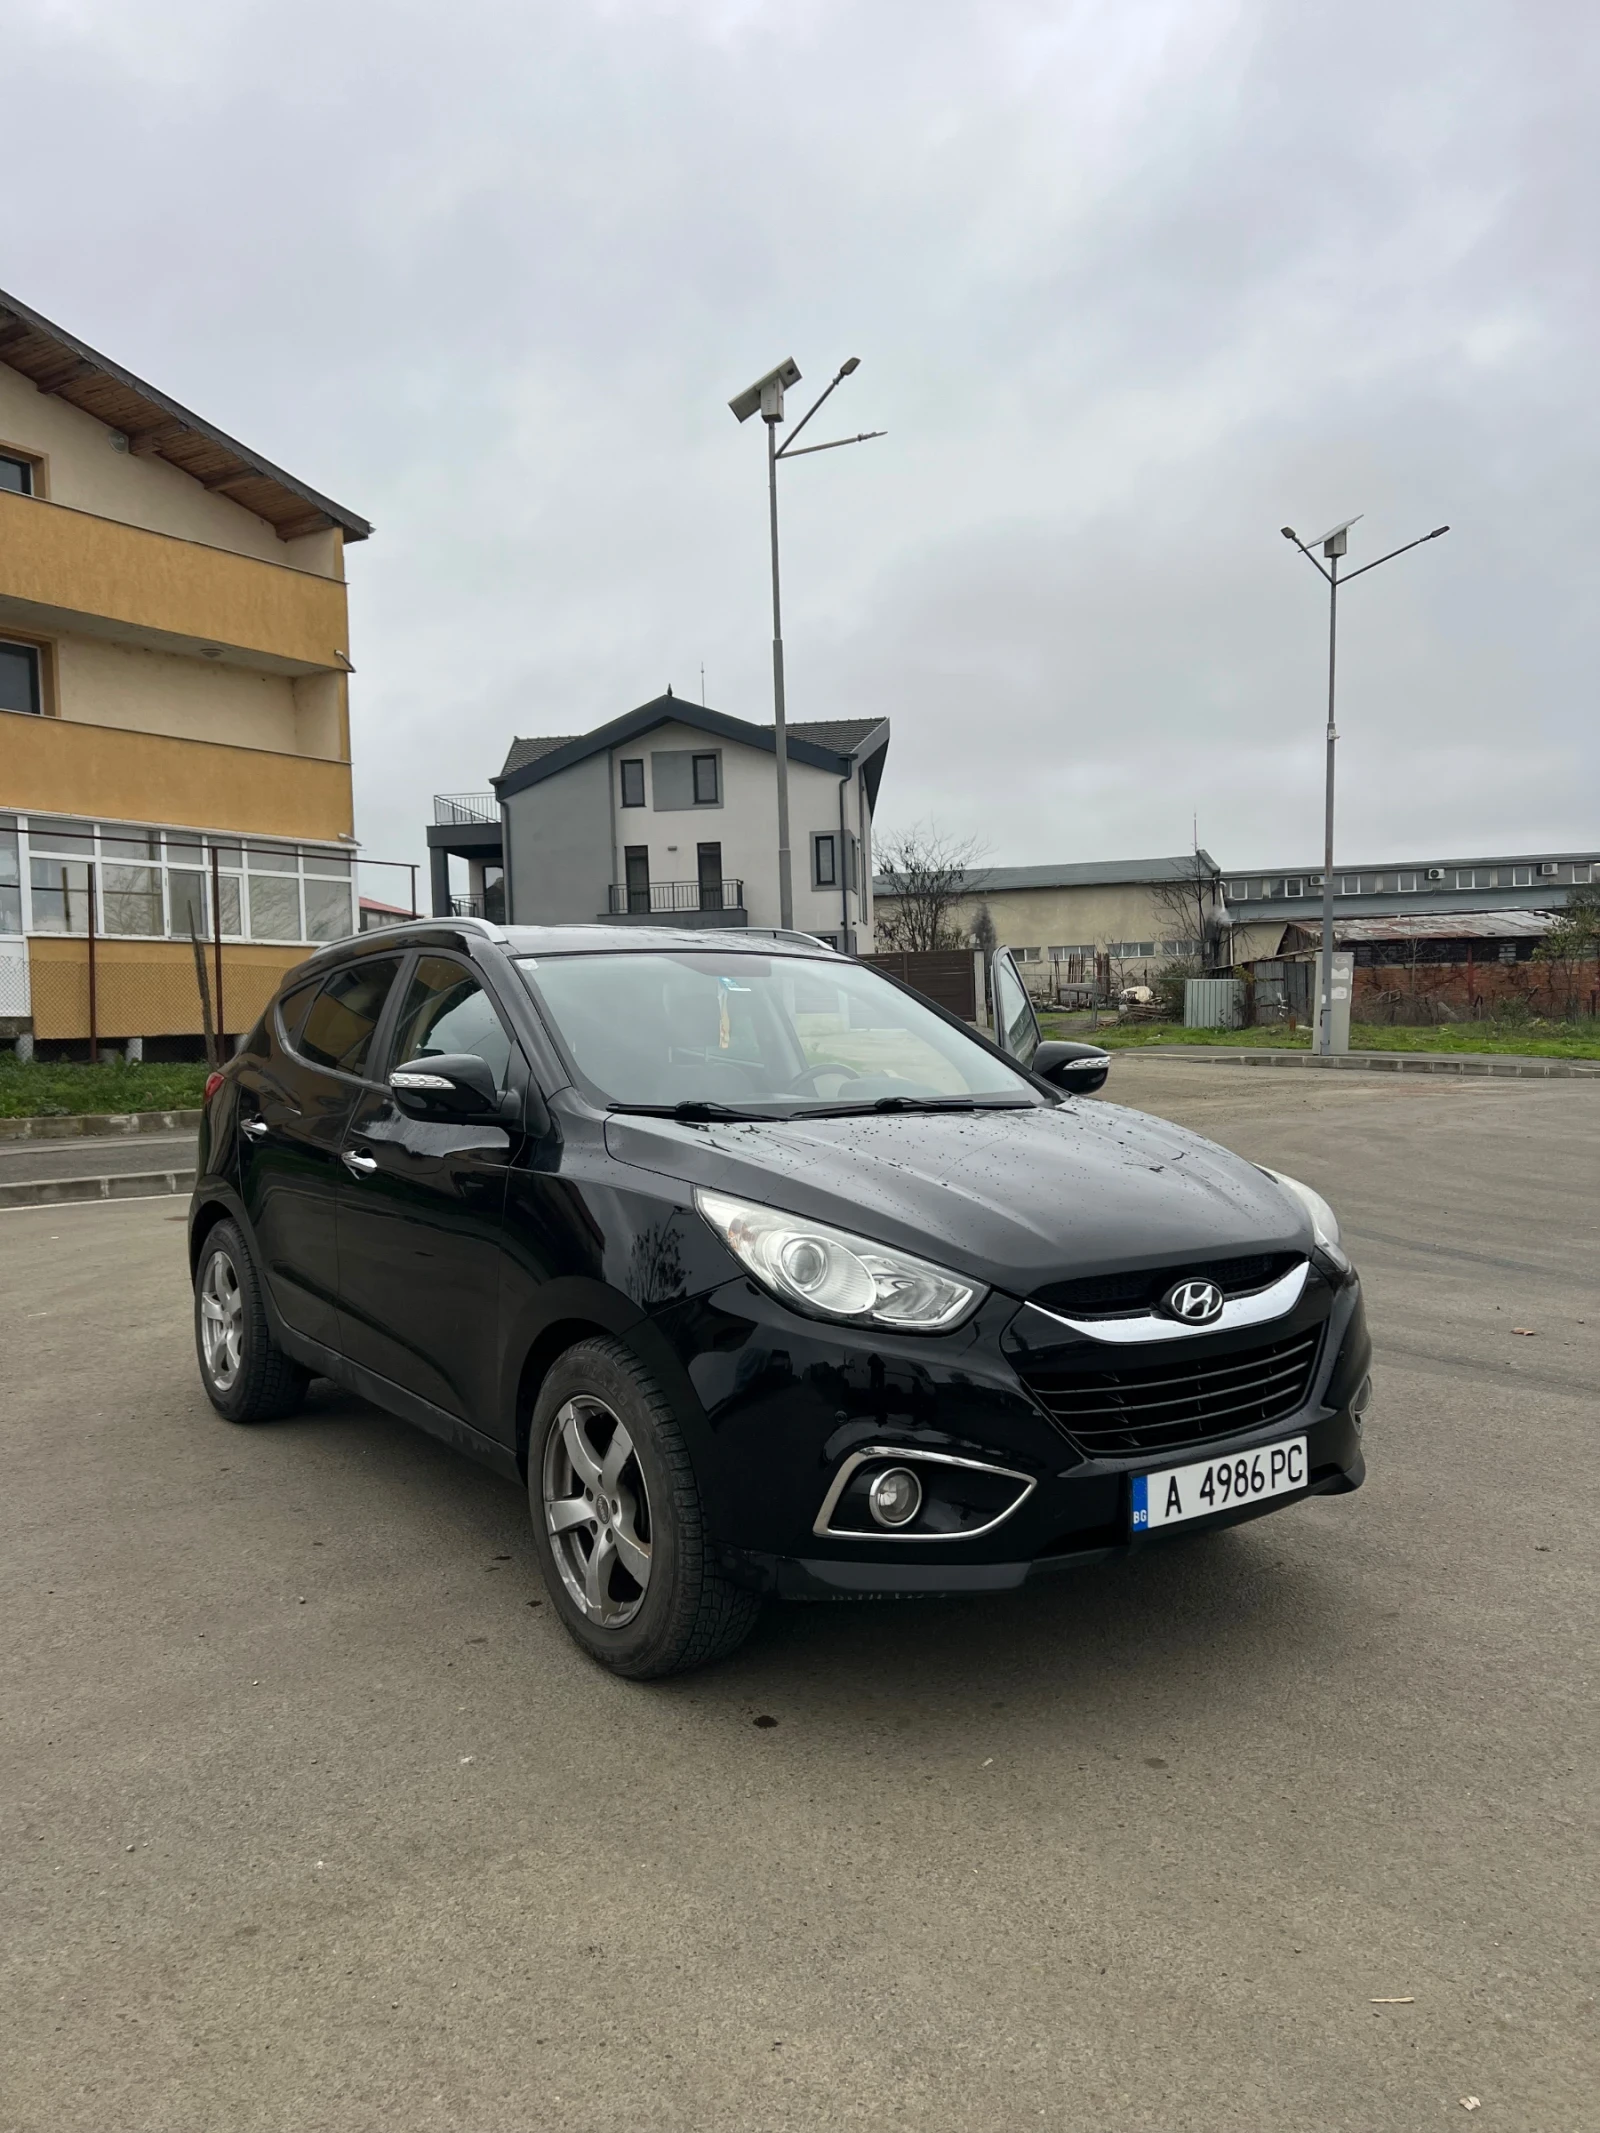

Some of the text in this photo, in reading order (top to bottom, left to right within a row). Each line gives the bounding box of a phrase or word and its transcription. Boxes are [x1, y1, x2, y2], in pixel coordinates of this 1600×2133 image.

[1165, 1444, 1303, 1518] A 4986 PC
[1133, 1510, 1147, 1525] BG
